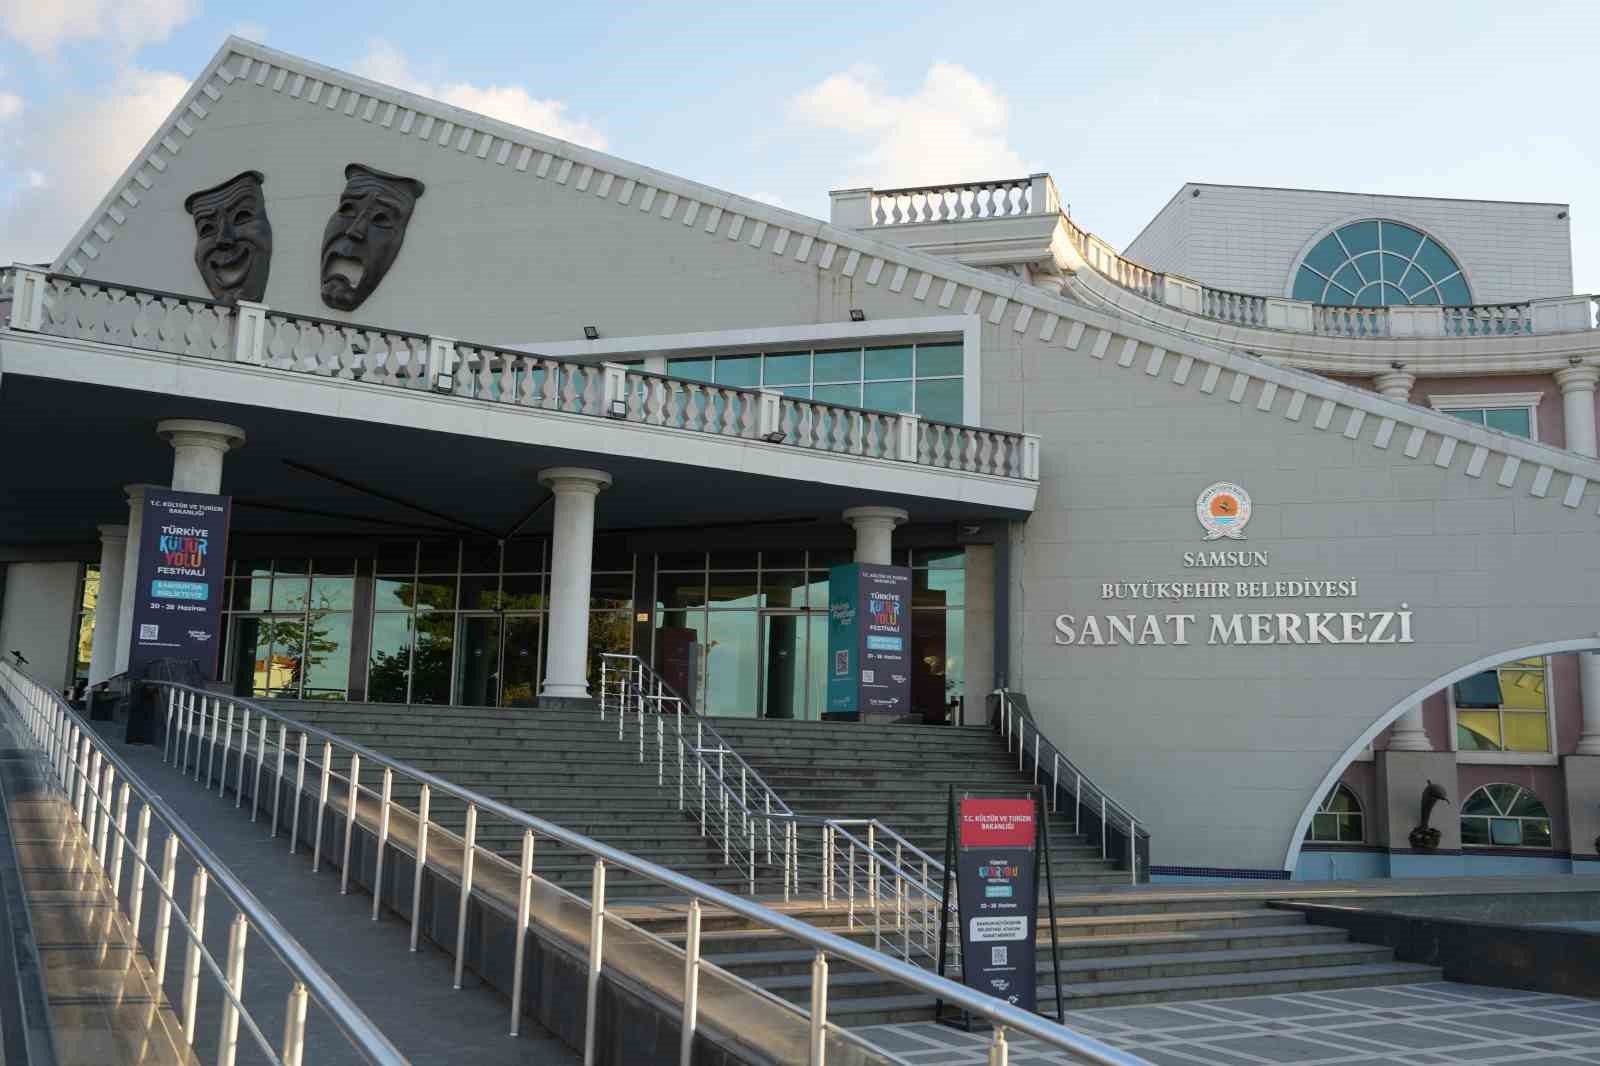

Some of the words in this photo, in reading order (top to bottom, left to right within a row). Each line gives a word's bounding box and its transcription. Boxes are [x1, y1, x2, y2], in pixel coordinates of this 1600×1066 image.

[161, 525, 209, 537] TÜRKİYE
[159, 535, 208, 555] KÜLTÜR
[165, 551, 203, 568] YOLU
[1183, 551, 1269, 568] SAMSUN
[157, 566, 206, 577] FESTİVALİ
[1101, 577, 1231, 601] BÜYÜKŞEHİR
[1236, 577, 1359, 598] BELEDİYESİ
[1055, 613, 1196, 646] SANAT
[1207, 602, 1415, 646] MERKEZİ
